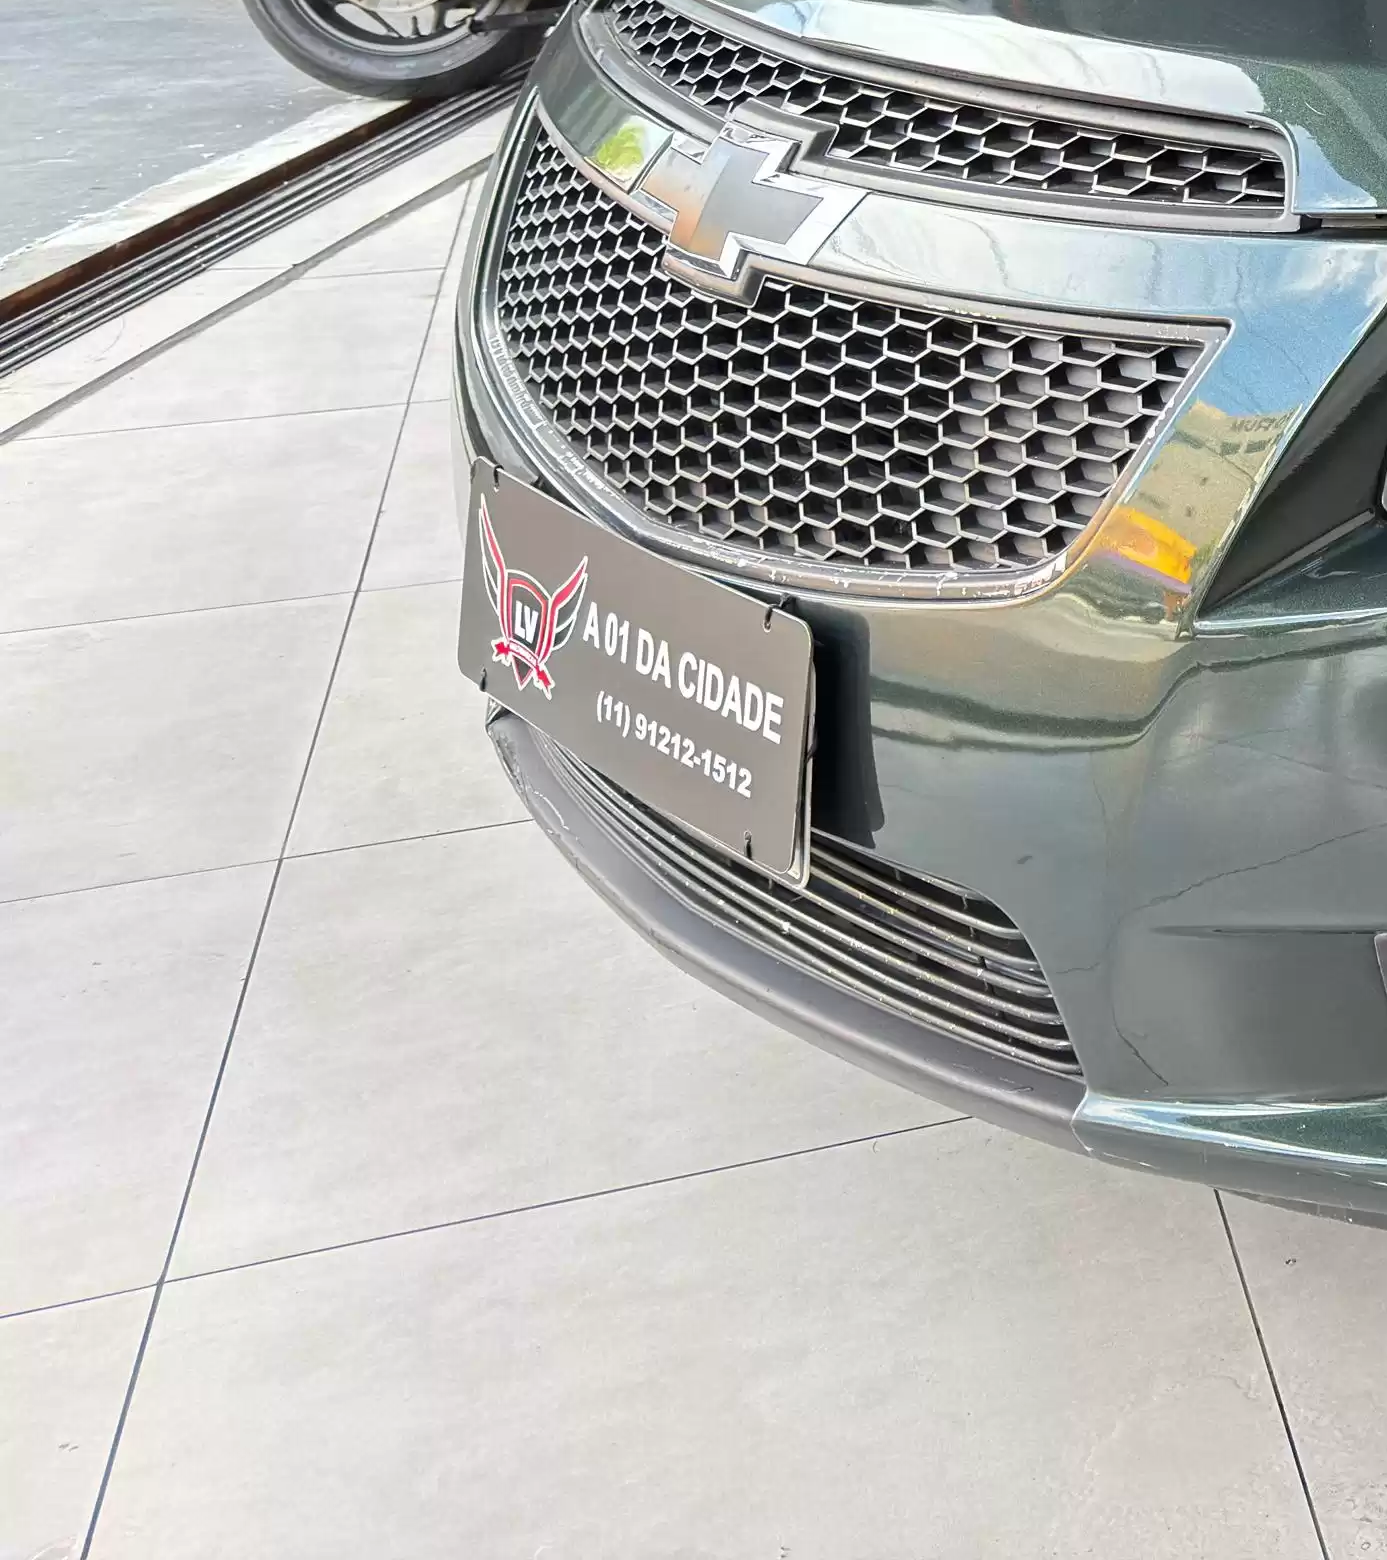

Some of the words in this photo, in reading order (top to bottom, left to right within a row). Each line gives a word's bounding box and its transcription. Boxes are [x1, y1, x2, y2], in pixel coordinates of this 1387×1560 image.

[514, 600, 539, 644] LV
[582, 601, 600, 649] A
[604, 612, 631, 664] 01
[636, 628, 672, 689] DA
[678, 652, 784, 744] CIDADE
[596, 691, 631, 737] (11)
[635, 712, 752, 797] 91212-1512
